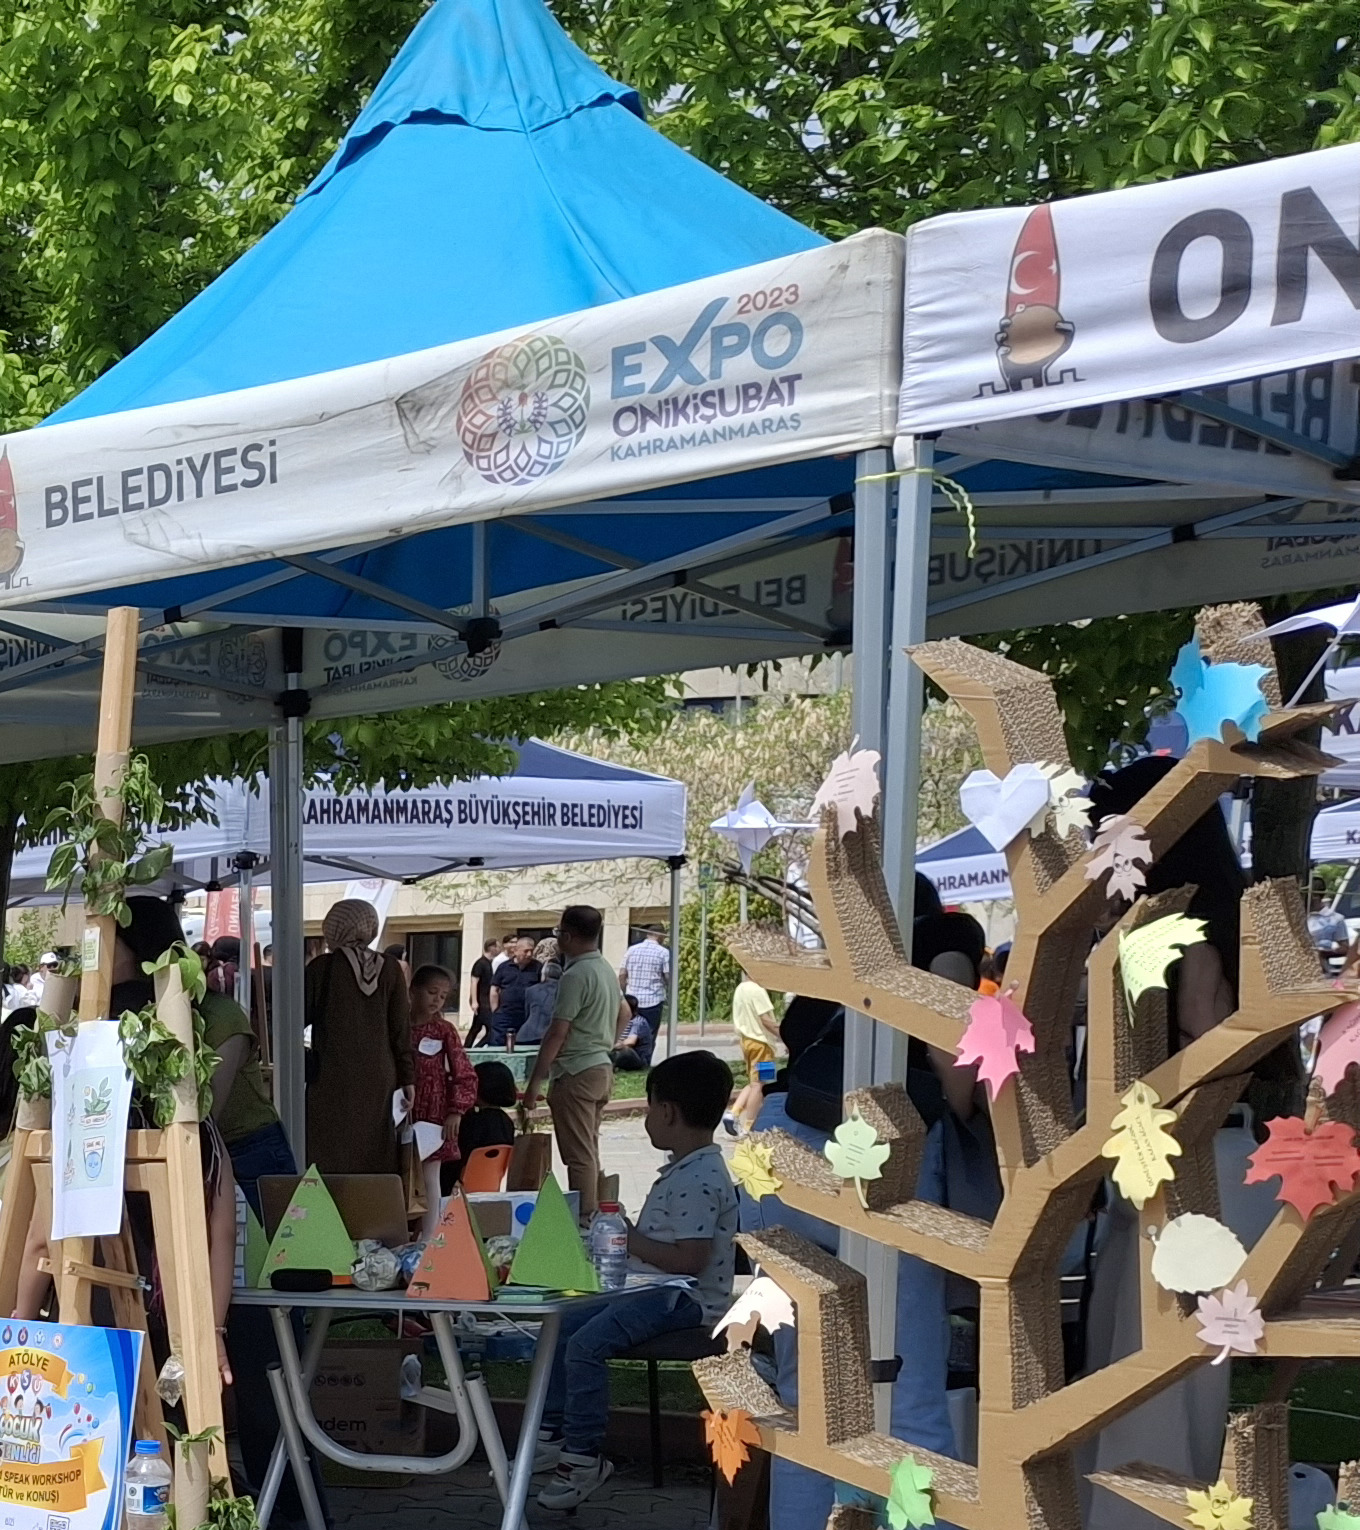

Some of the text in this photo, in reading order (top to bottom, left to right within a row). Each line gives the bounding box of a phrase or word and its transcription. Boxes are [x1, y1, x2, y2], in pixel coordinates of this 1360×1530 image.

[736, 282, 801, 318] 2023
[609, 297, 804, 398] EXPO
[609, 413, 803, 462] KAHRAMANMARAŞ
[44, 439, 279, 530] BELEDİYESİ
[458, 794, 557, 830] BÜYÜKŞEHİR
[560, 799, 644, 830] BELEDİYESİ
[8, 1349, 50, 1371] ATÖLYE
[0, 1413, 42, 1442] ÇOCUK
[4, 1470, 30, 1485] SPEAK
[32, 1469, 82, 1485] WORKSHOP
[15, 1492, 25, 1501] ve
